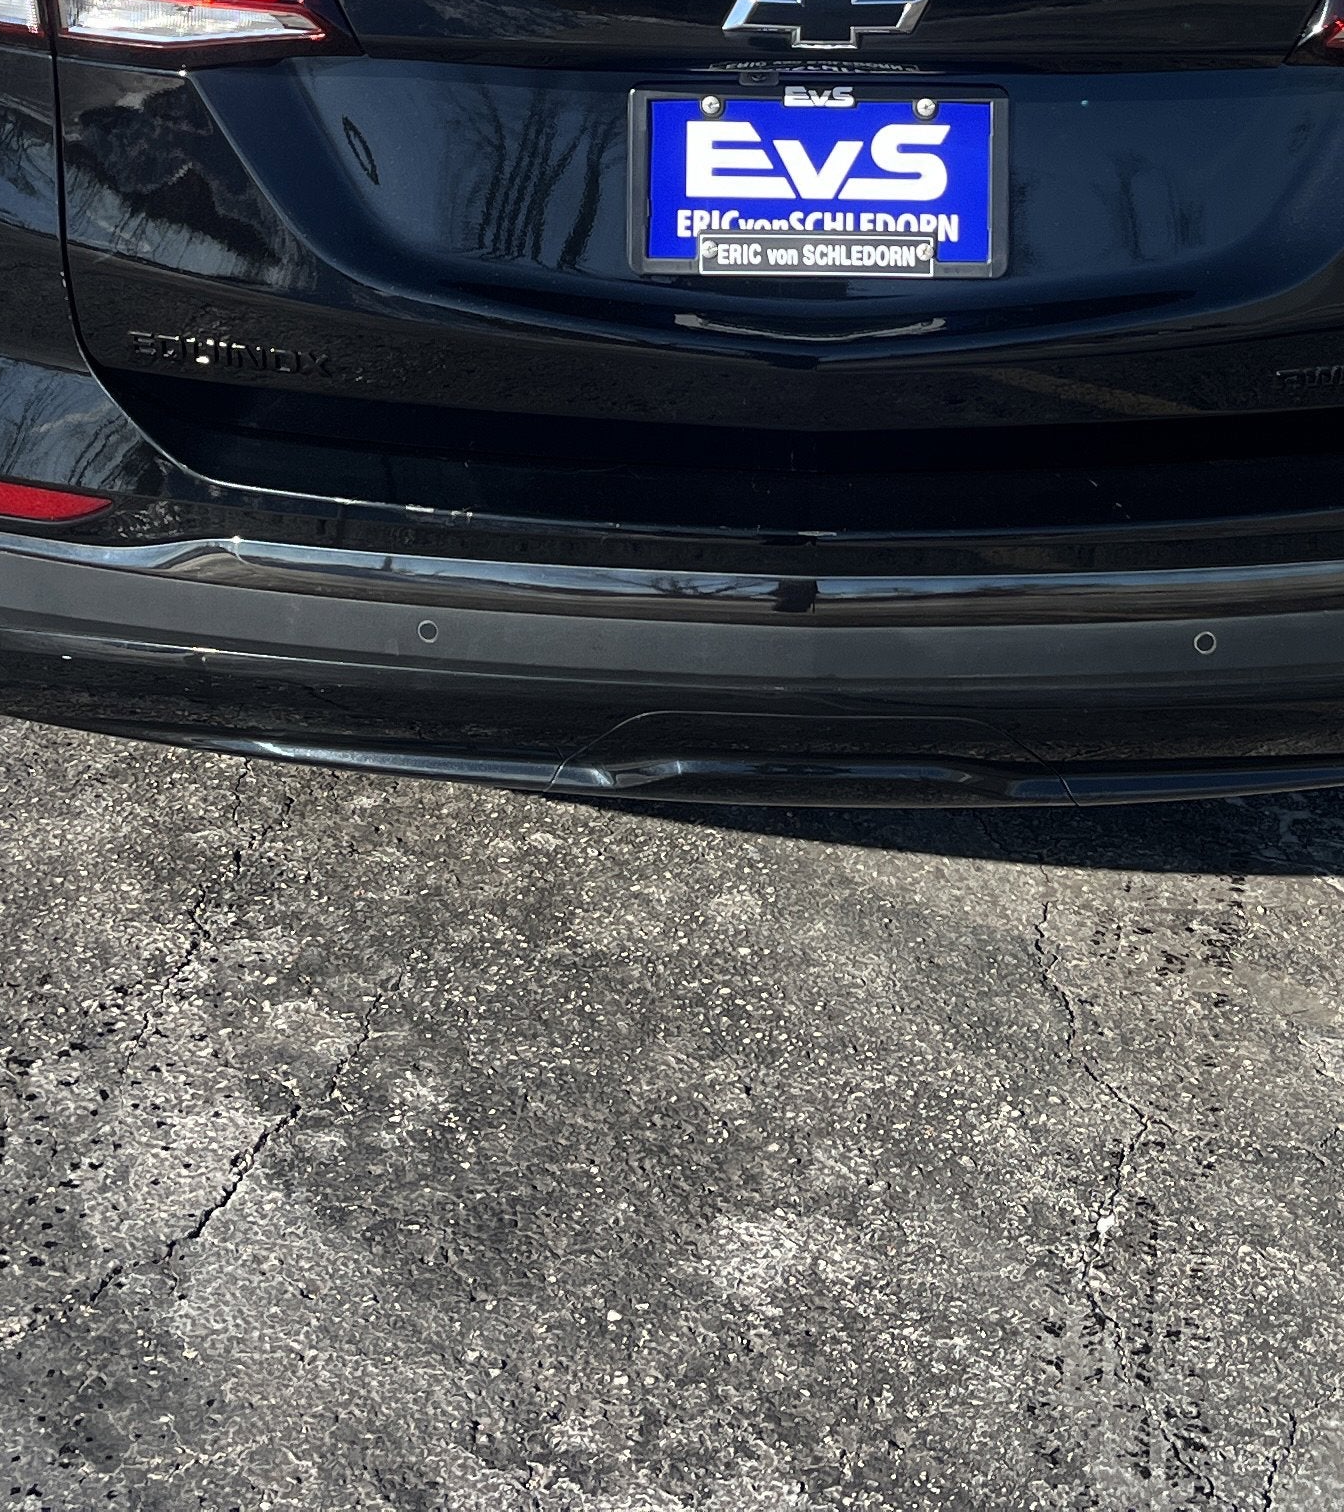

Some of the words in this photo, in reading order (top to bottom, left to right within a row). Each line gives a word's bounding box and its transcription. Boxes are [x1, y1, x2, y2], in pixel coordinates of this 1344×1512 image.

[717, 245, 763, 265] ERIC
[766, 248, 798, 266] von
[802, 245, 916, 267] SCHLEDORN
